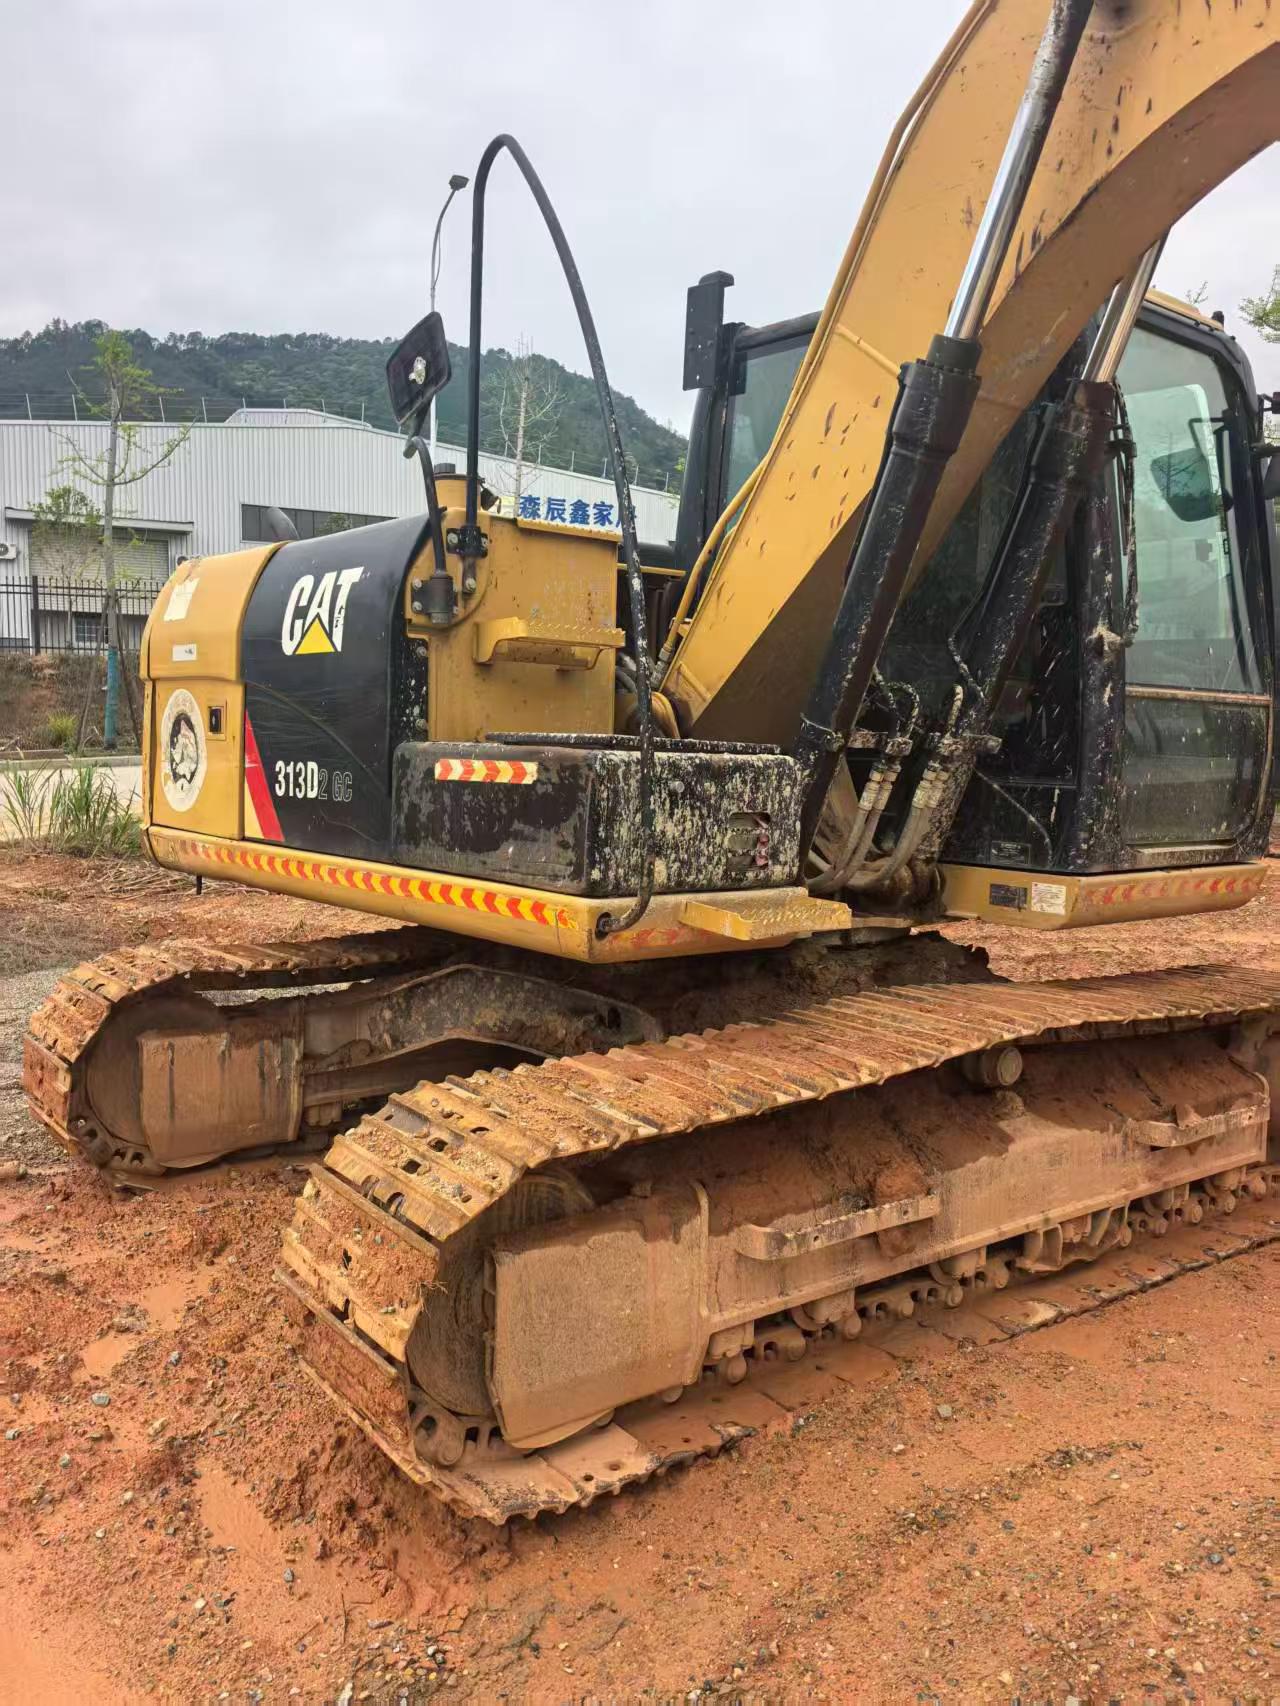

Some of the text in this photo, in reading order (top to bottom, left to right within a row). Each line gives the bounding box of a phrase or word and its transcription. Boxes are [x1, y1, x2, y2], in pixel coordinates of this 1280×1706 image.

[519, 495, 636, 528] 森辰鑫家
[281, 567, 364, 656] CAT
[331, 772, 353, 803] GC
